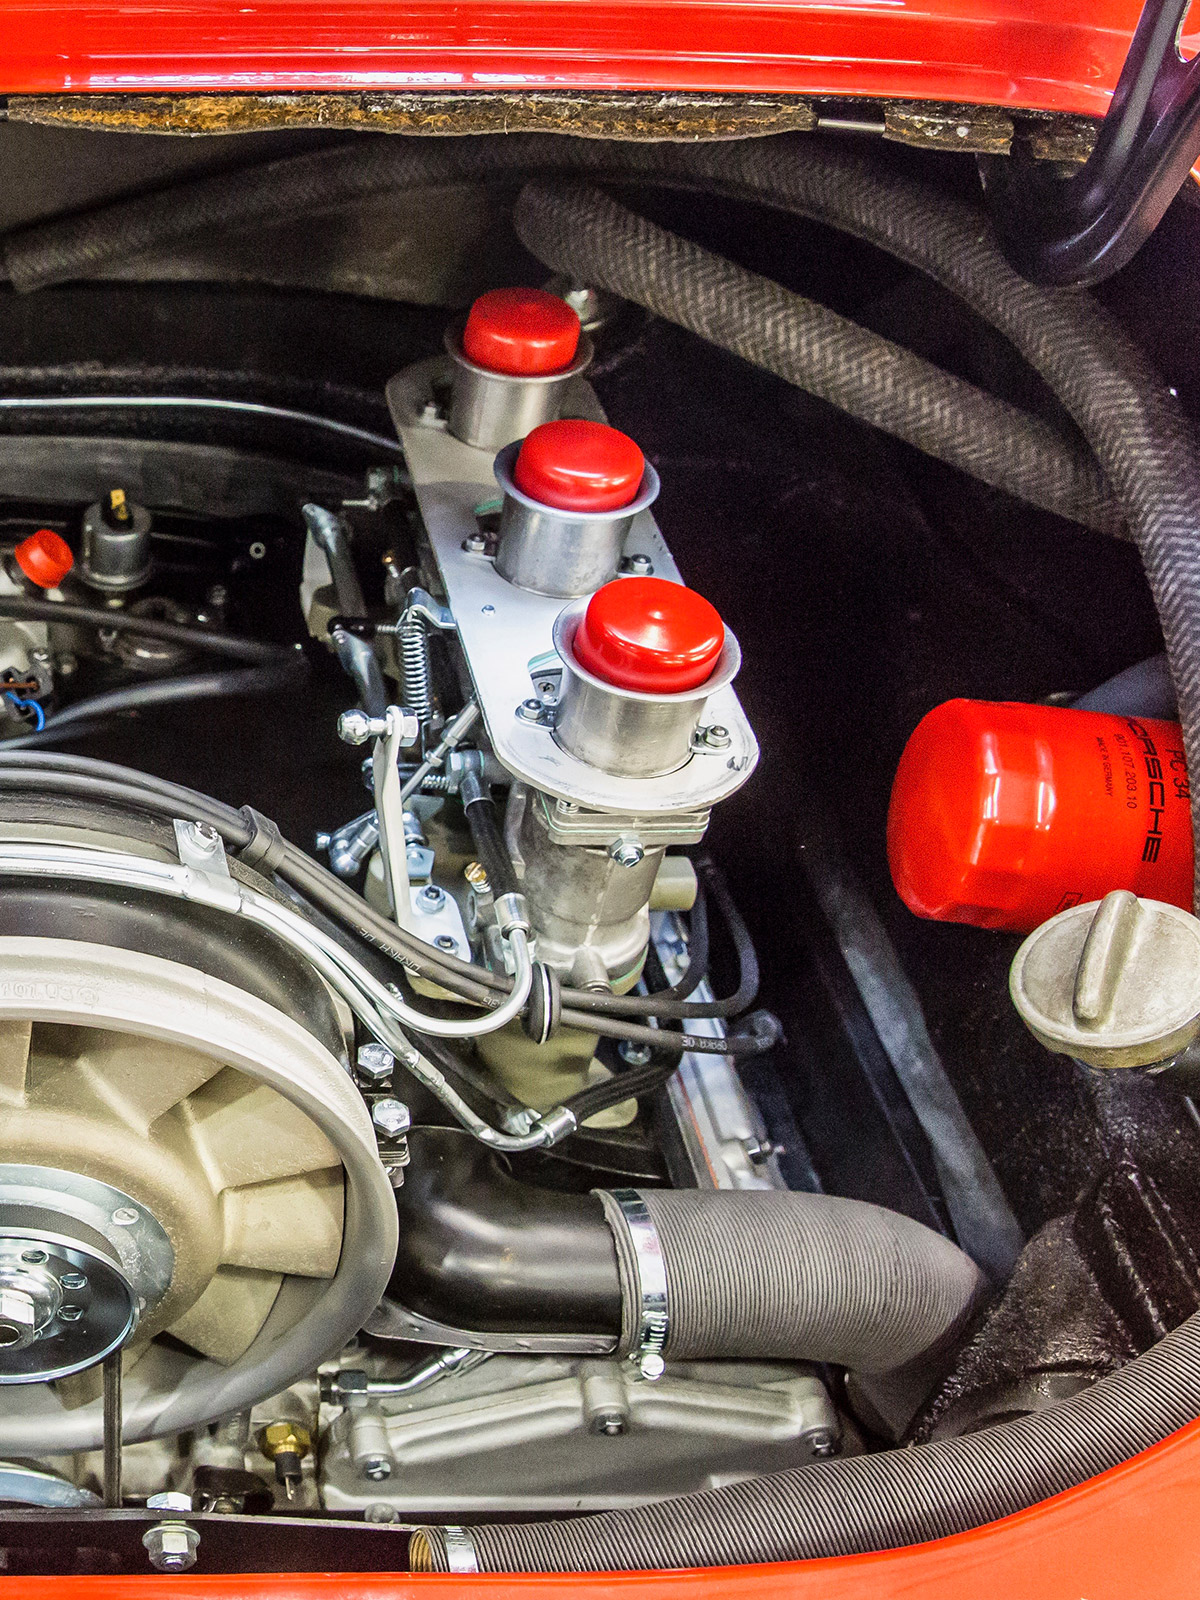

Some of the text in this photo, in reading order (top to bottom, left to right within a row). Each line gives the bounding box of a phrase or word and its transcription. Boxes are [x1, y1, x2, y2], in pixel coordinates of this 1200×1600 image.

[1102, 762, 1113, 797] GERMANY
[1125, 716, 1165, 864] ORSCHE
[1173, 777, 1190, 799] 34
